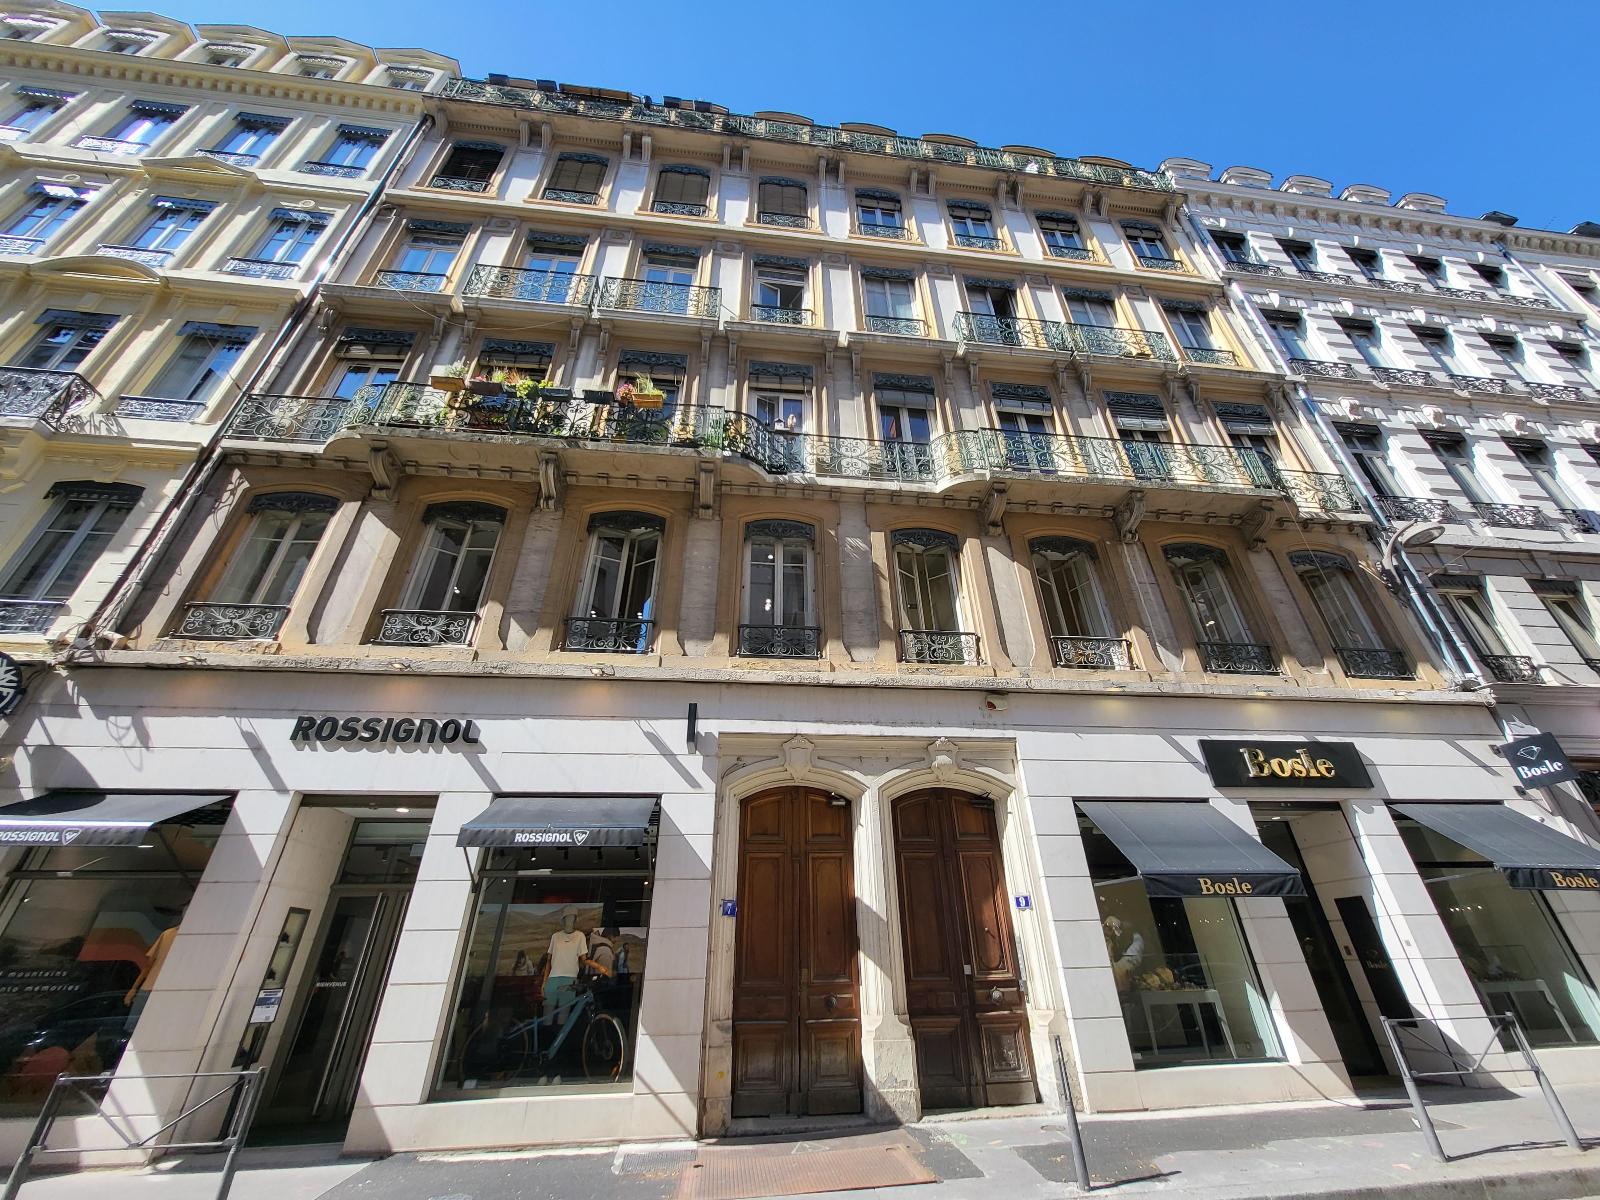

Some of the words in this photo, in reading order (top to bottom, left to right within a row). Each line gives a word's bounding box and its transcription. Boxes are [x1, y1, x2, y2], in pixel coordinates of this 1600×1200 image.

[289, 715, 479, 744] ROSSIGNOL
[1239, 748, 1335, 778] Bosle
[1516, 759, 1564, 779] Bosle
[514, 832, 573, 843] ROSSIGNOL
[1197, 877, 1253, 895] Bosle
[1548, 871, 1600, 888] Bosle
[1018, 896, 1026, 907] 9
